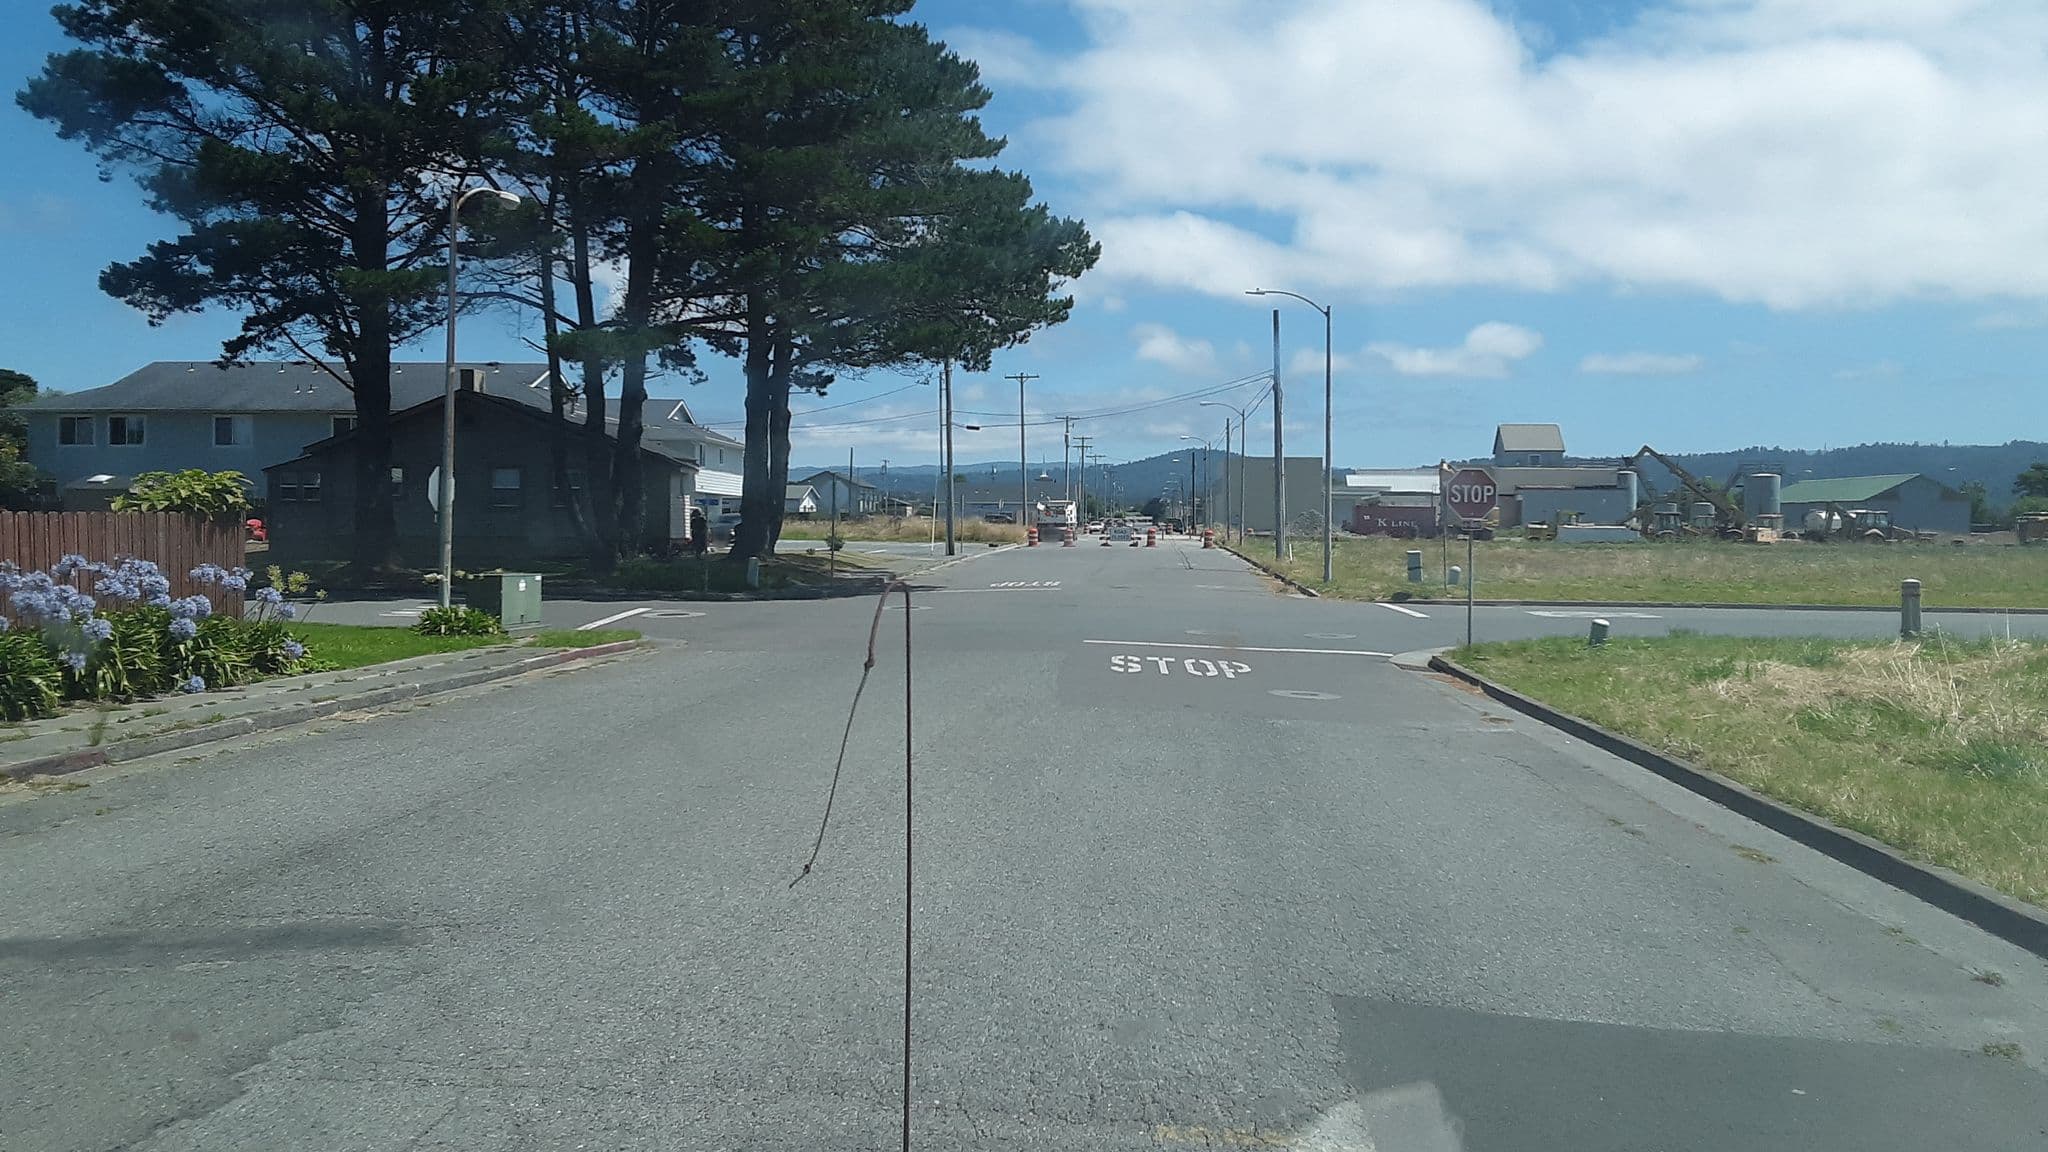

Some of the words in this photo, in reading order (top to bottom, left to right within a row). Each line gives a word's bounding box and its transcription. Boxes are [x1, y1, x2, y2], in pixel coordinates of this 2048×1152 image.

[1450, 484, 1494, 504] STOP
[1377, 517, 1388, 527] K
[1110, 654, 1252, 679] STOP
